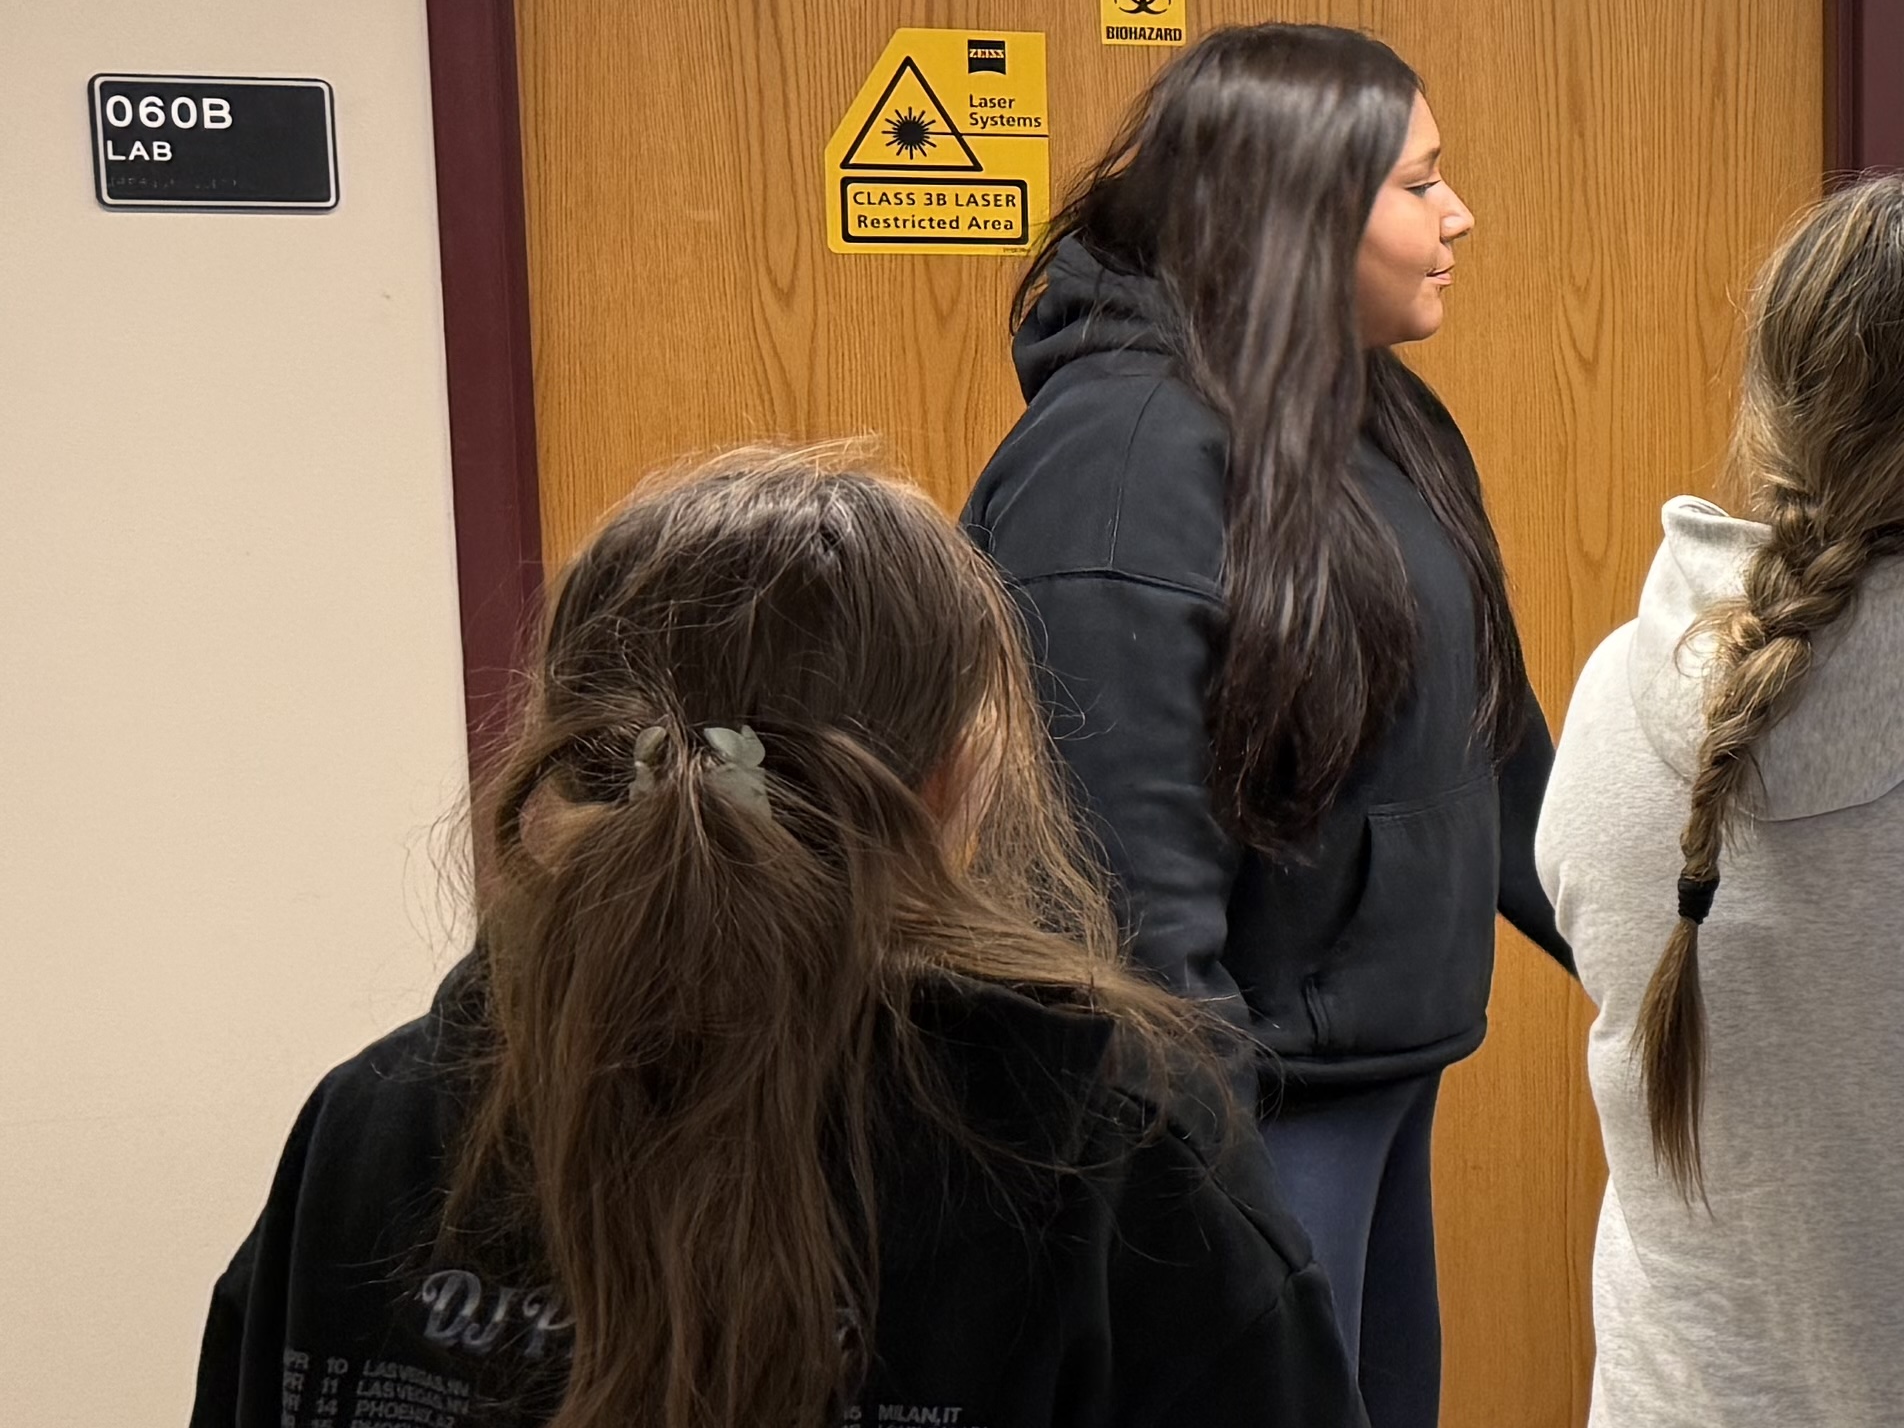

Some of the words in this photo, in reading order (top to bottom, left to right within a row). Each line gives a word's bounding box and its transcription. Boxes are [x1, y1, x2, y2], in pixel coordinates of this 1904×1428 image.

[1105, 25, 1183, 43] BIOHAZARD
[968, 47, 1005, 59] ZEISS
[968, 93, 1016, 110] Laser
[105, 94, 233, 130] 060B
[968, 112, 1043, 130] Systems
[106, 139, 173, 162] LAB
[852, 190, 917, 207] CLASS
[923, 192, 948, 207] 3B
[954, 192, 1018, 208] LASER
[856, 214, 961, 231] Restricted
[967, 215, 1015, 232] Area
[421, 1269, 517, 1356] DJ
[356, 1379, 394, 1399] LAS
[877, 1404, 942, 1426] MILAN,
